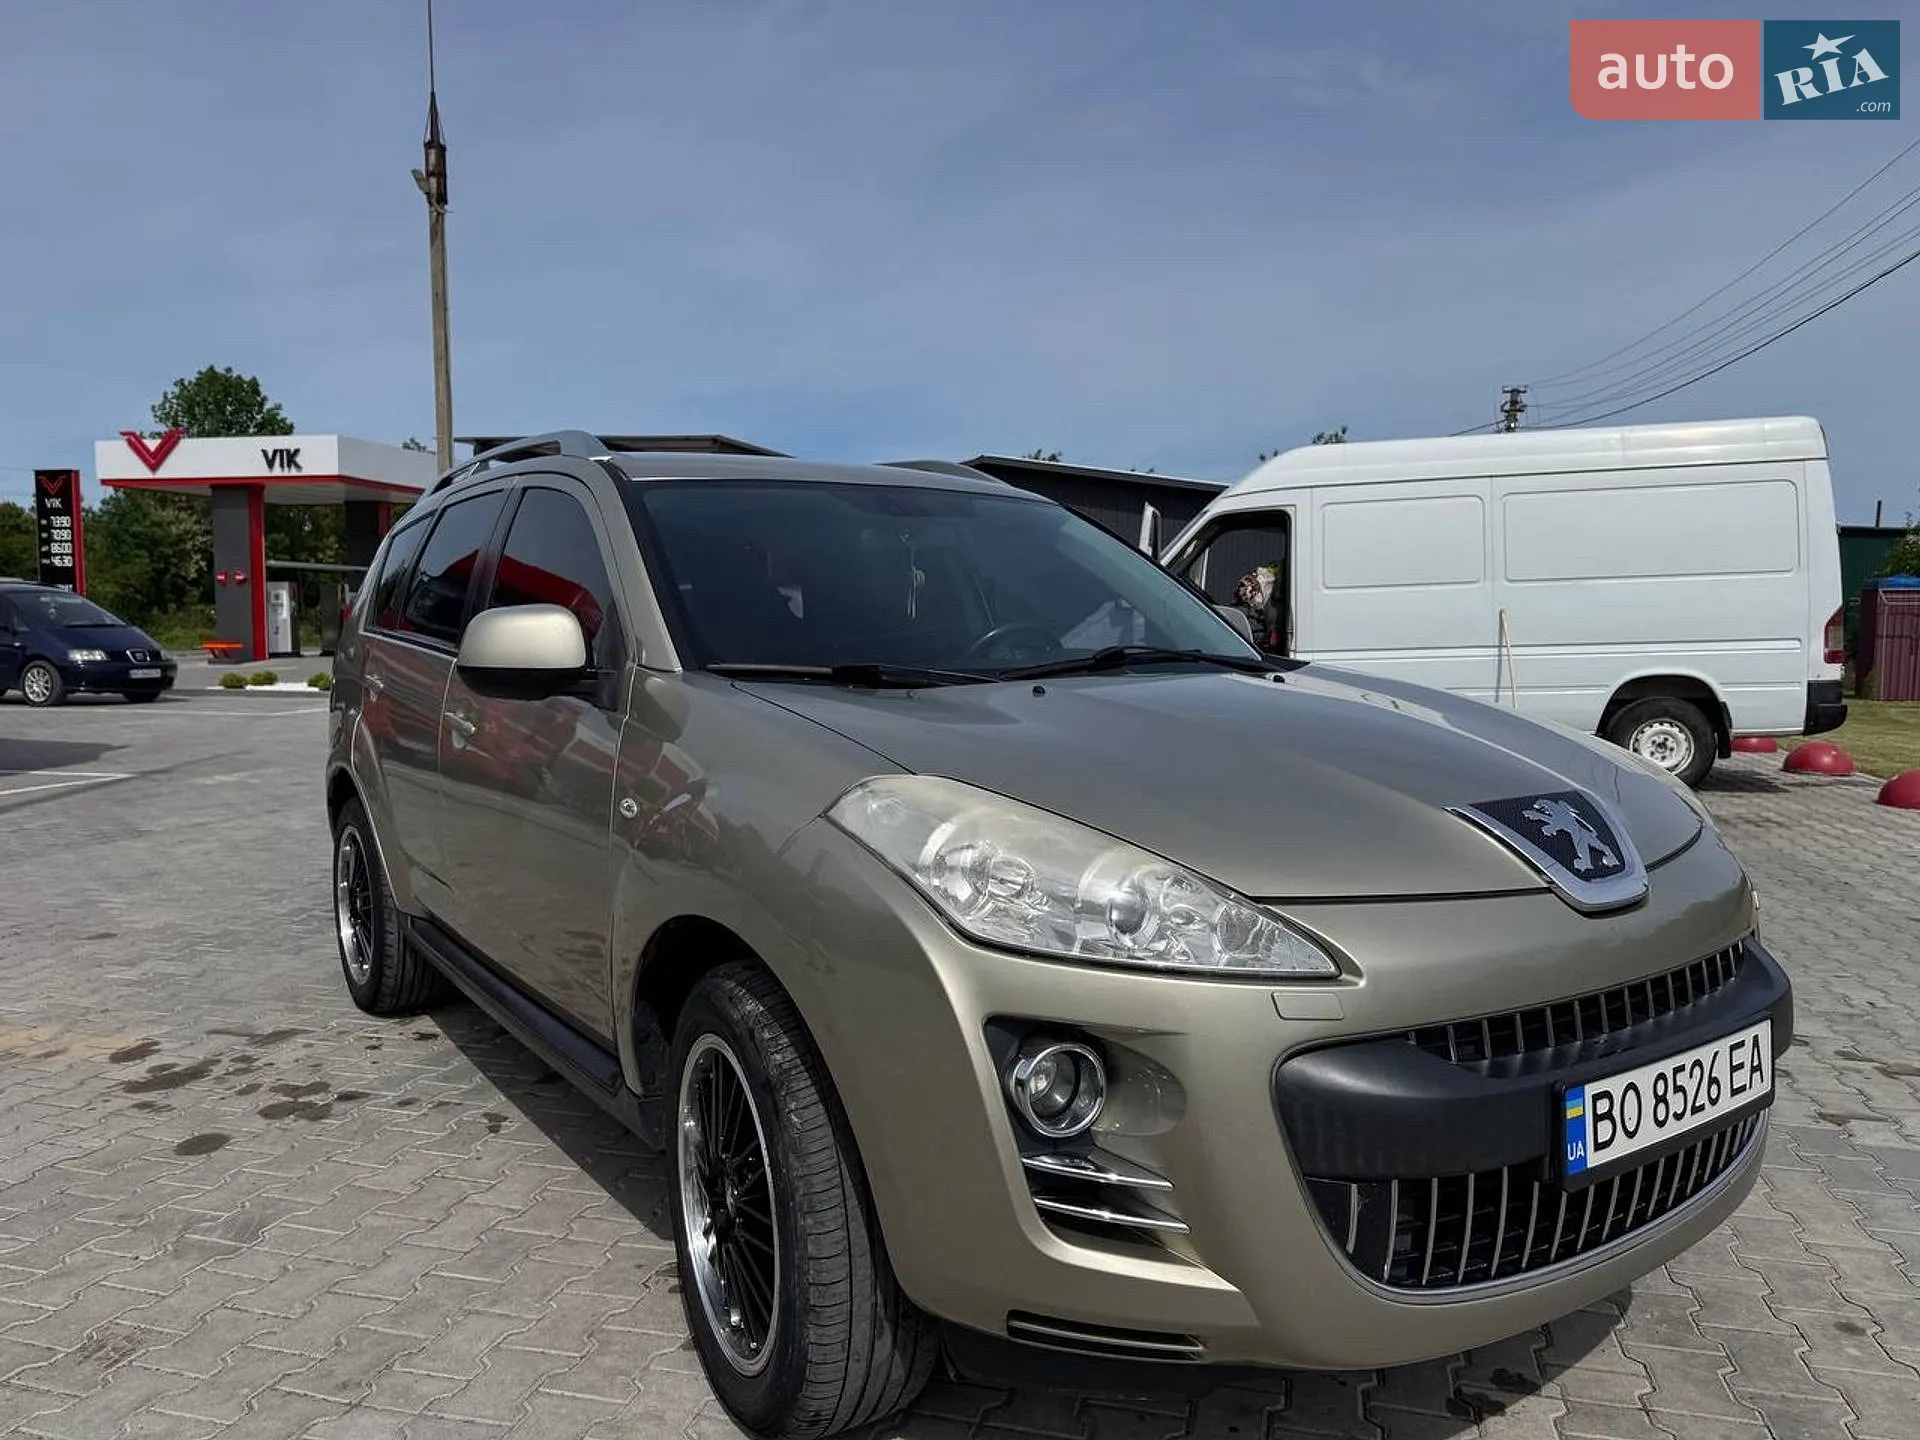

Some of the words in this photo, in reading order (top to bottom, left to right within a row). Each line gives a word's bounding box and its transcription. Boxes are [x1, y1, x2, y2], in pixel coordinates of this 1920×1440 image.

[261, 448, 304, 473] VIK
[44, 497, 62, 509] VIK
[1591, 1081, 1642, 1153] BO
[1652, 1050, 1722, 1129] 8526
[1729, 1033, 1765, 1098] EA
[1567, 1142, 1585, 1161] UA
